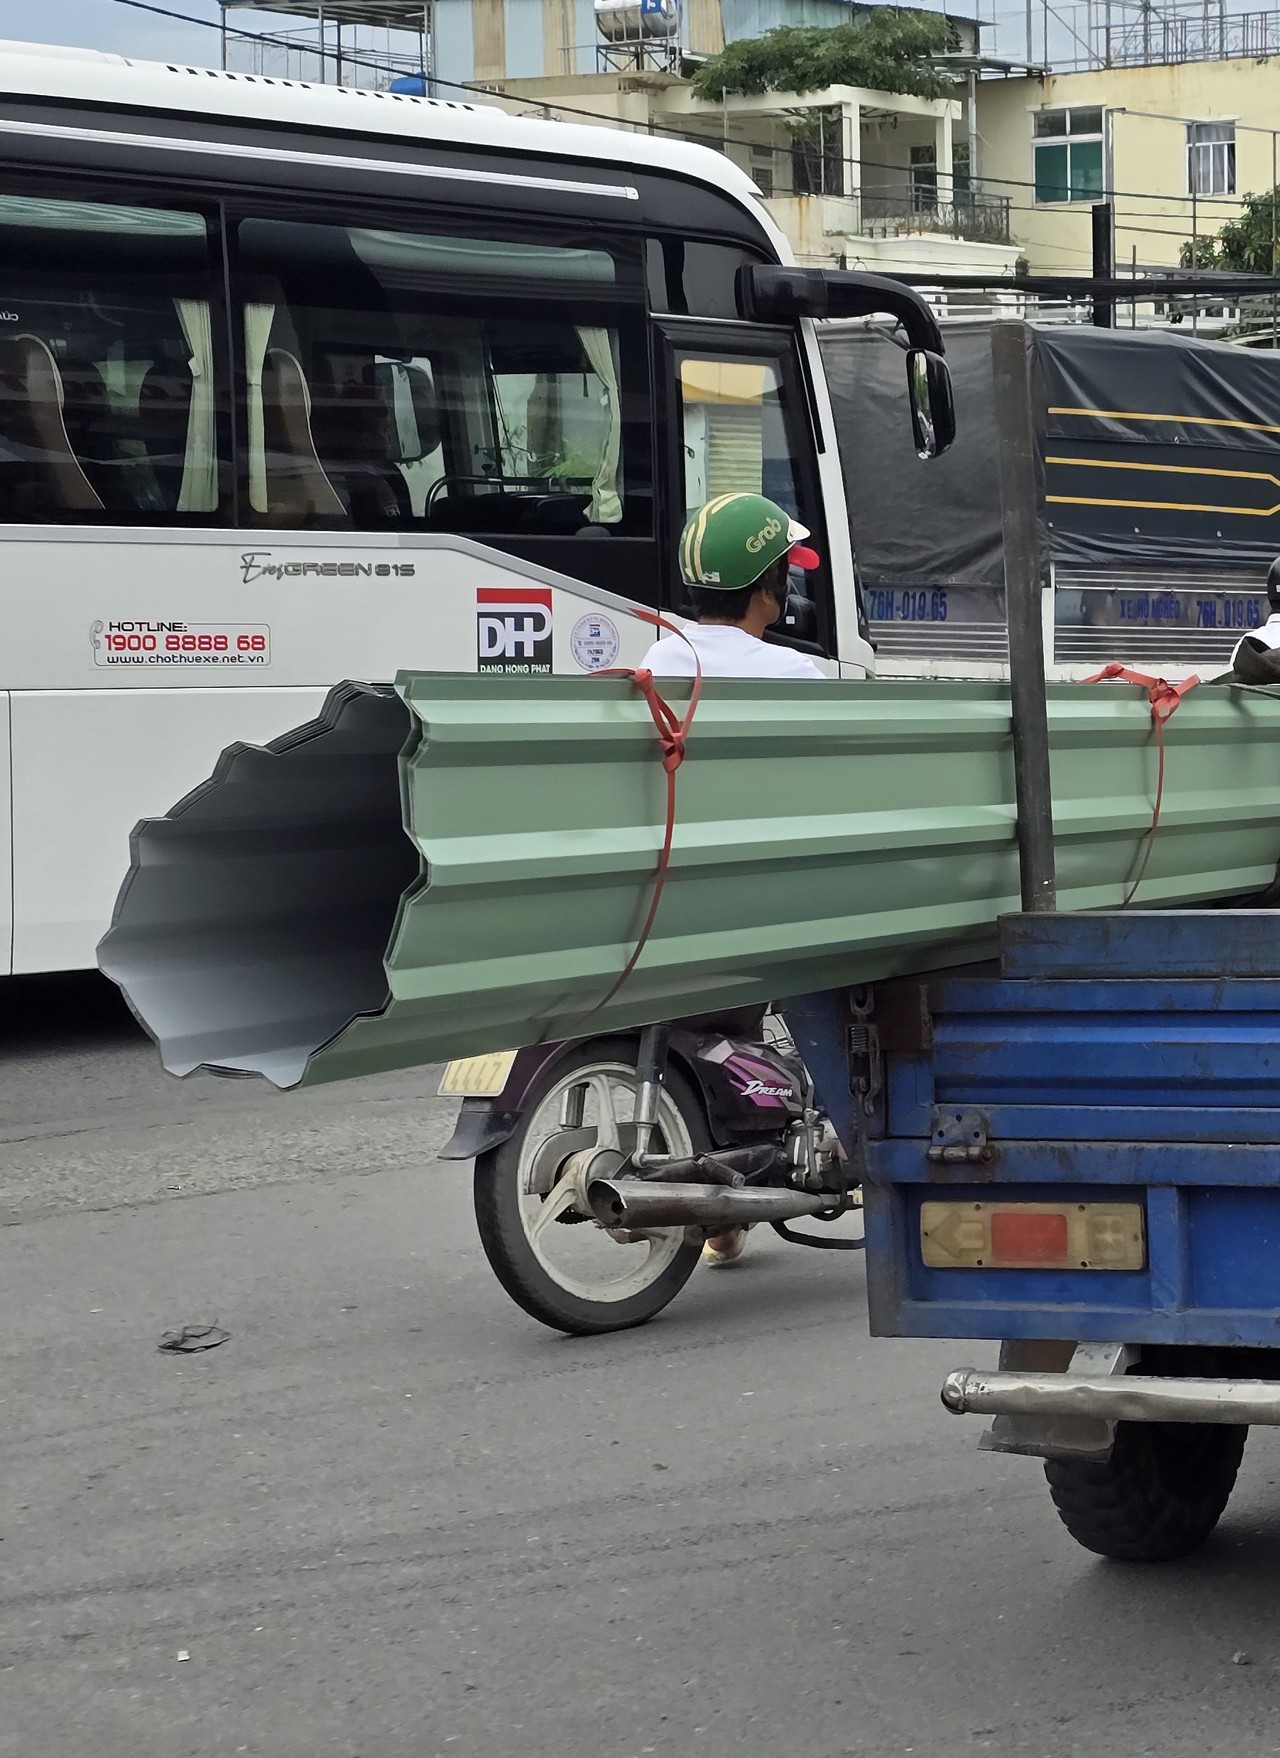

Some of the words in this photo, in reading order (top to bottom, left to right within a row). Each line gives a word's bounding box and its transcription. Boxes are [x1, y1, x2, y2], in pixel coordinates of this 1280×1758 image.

[746, 517, 781, 553] Grab
[109, 622, 187, 632] HOTLINE:
[477, 603, 552, 657] DHP
[105, 635, 156, 651] 1900
[165, 635, 228, 651] 8888
[237, 635, 265, 651] 68
[107, 654, 264, 664] www.chothuexe.net.vn
